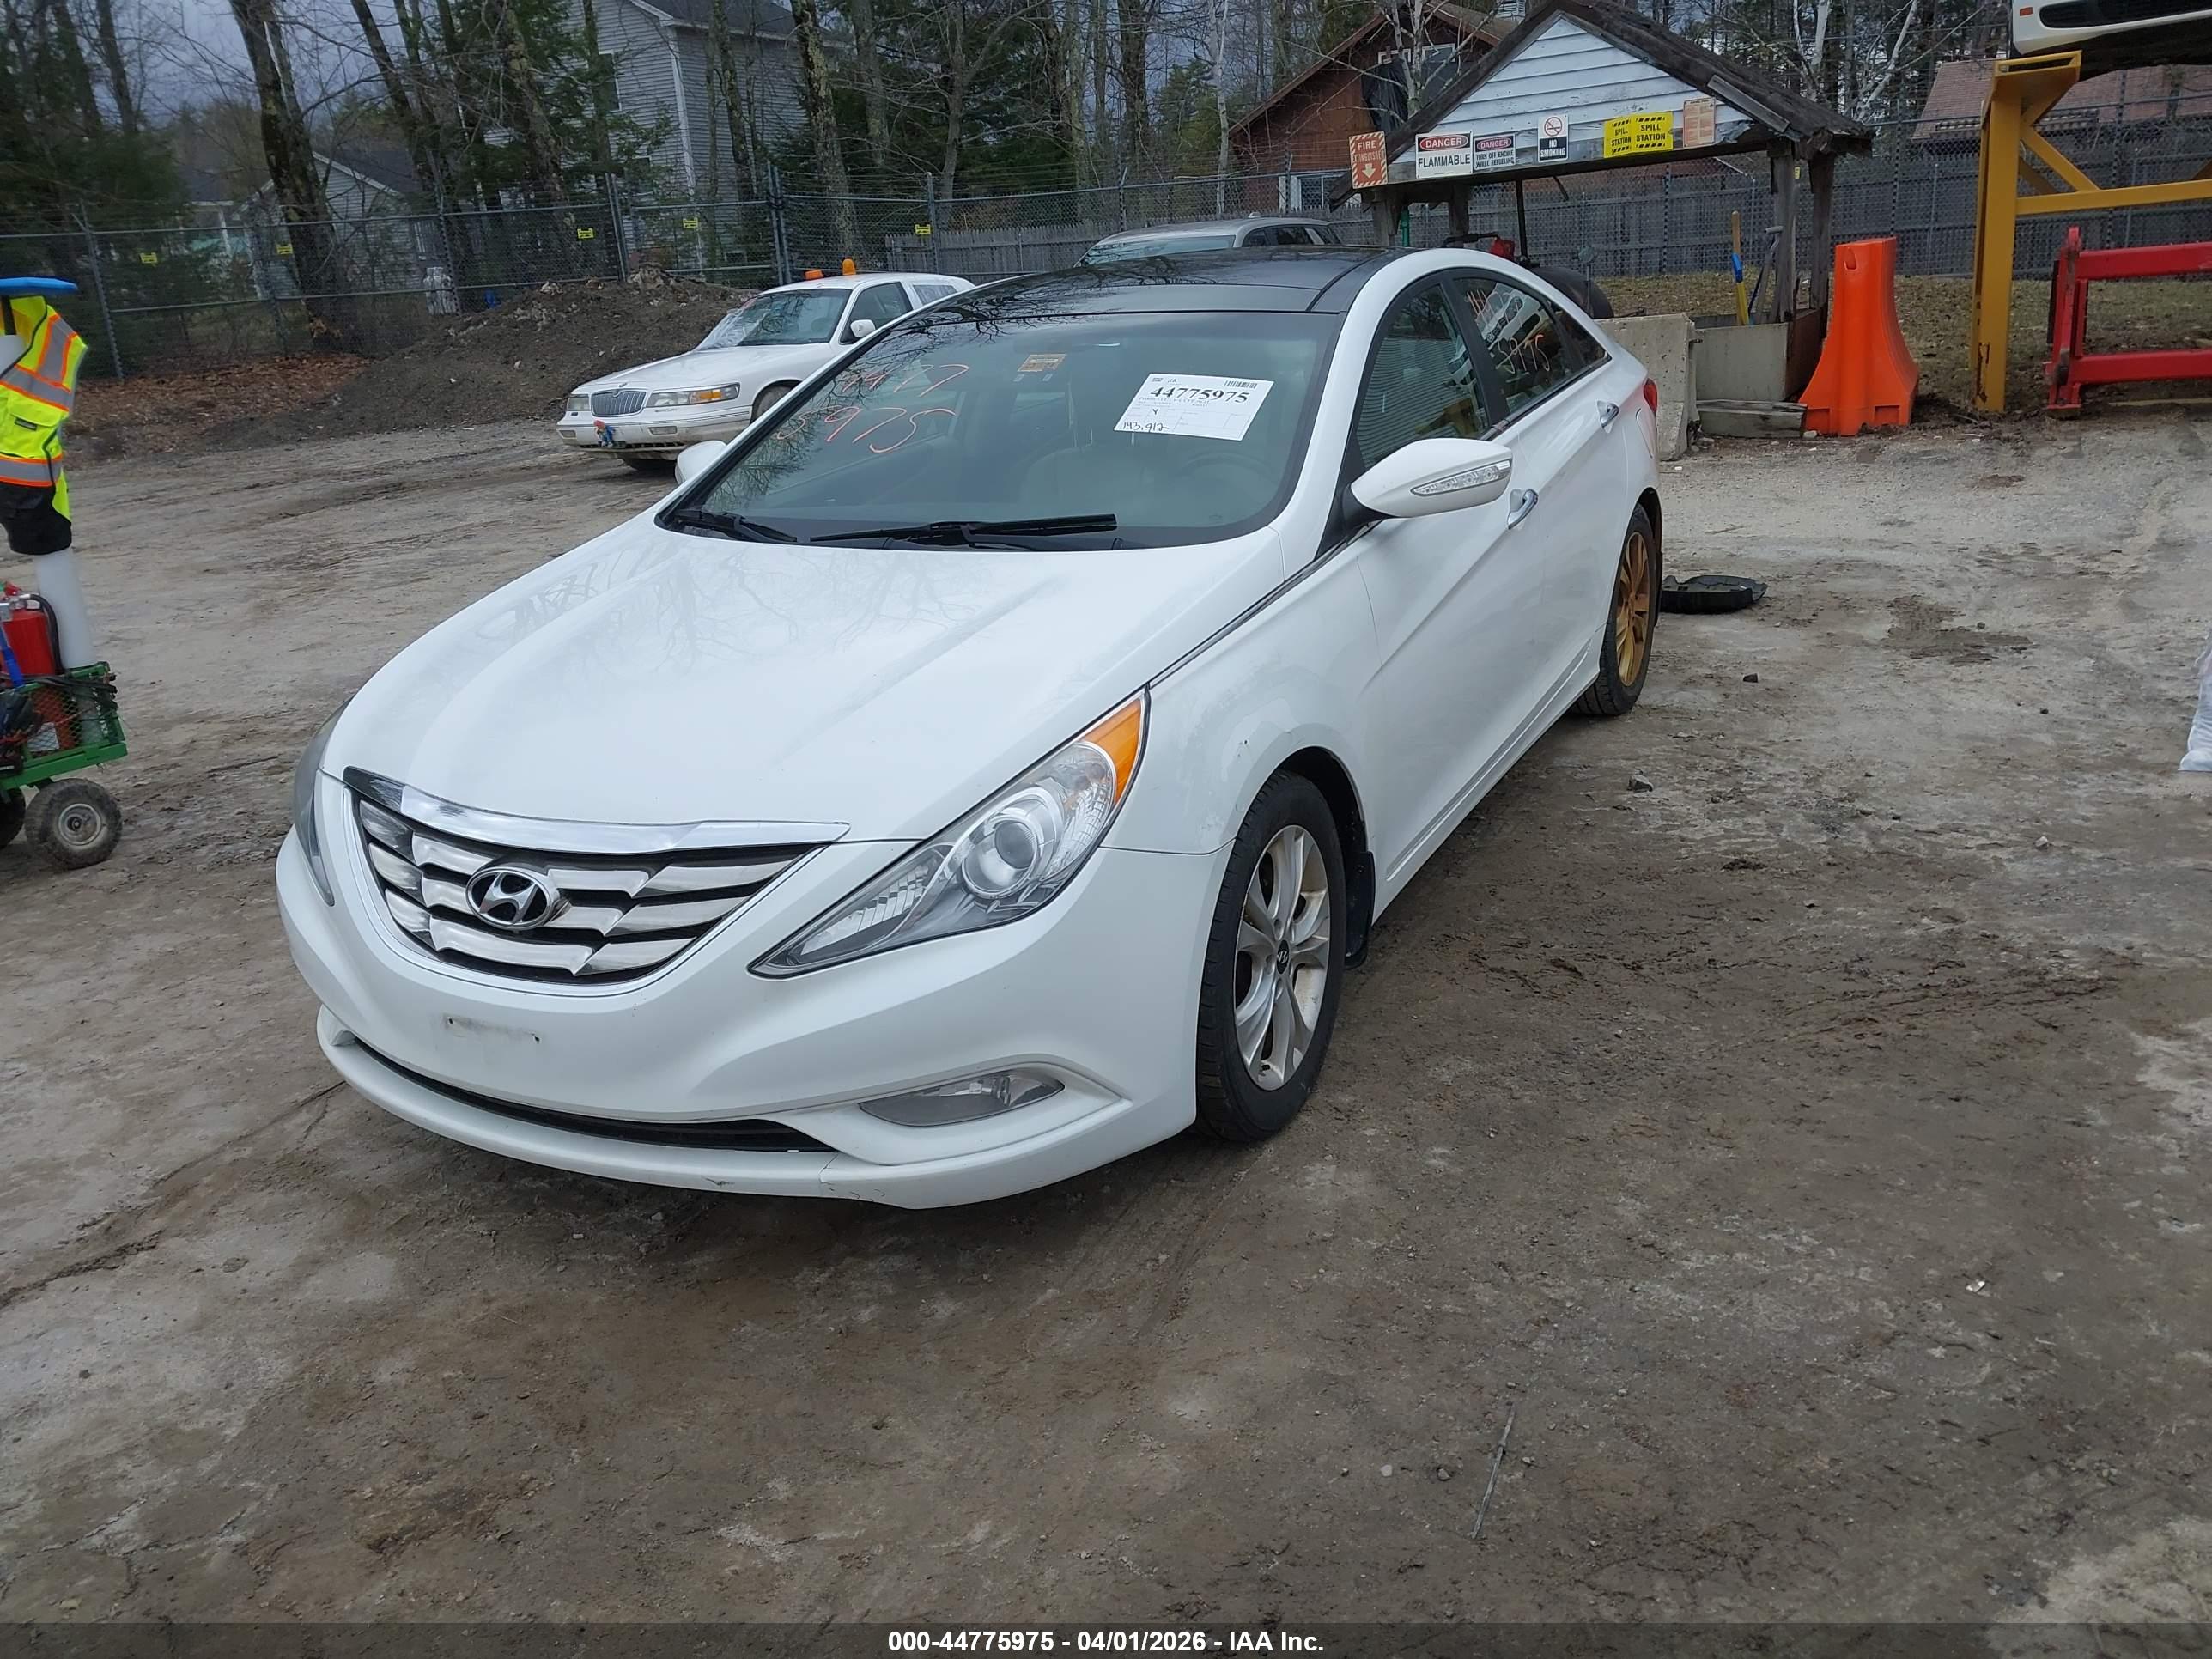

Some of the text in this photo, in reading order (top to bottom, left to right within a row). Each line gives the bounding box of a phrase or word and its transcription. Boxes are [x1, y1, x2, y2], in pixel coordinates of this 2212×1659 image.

[1425, 137, 1463, 149] DANGER
[1612, 137, 1632, 147] STATION
[1636, 132, 1666, 143] STATION
[1357, 139, 1377, 151] FIRE
[1480, 139, 1509, 150] DANGER
[1548, 139, 1558, 148] NO
[1540, 148, 1566, 158] SMOKING
[1418, 153, 1471, 168] FLAMMABLE
[1149, 386, 1250, 404] 44775975
